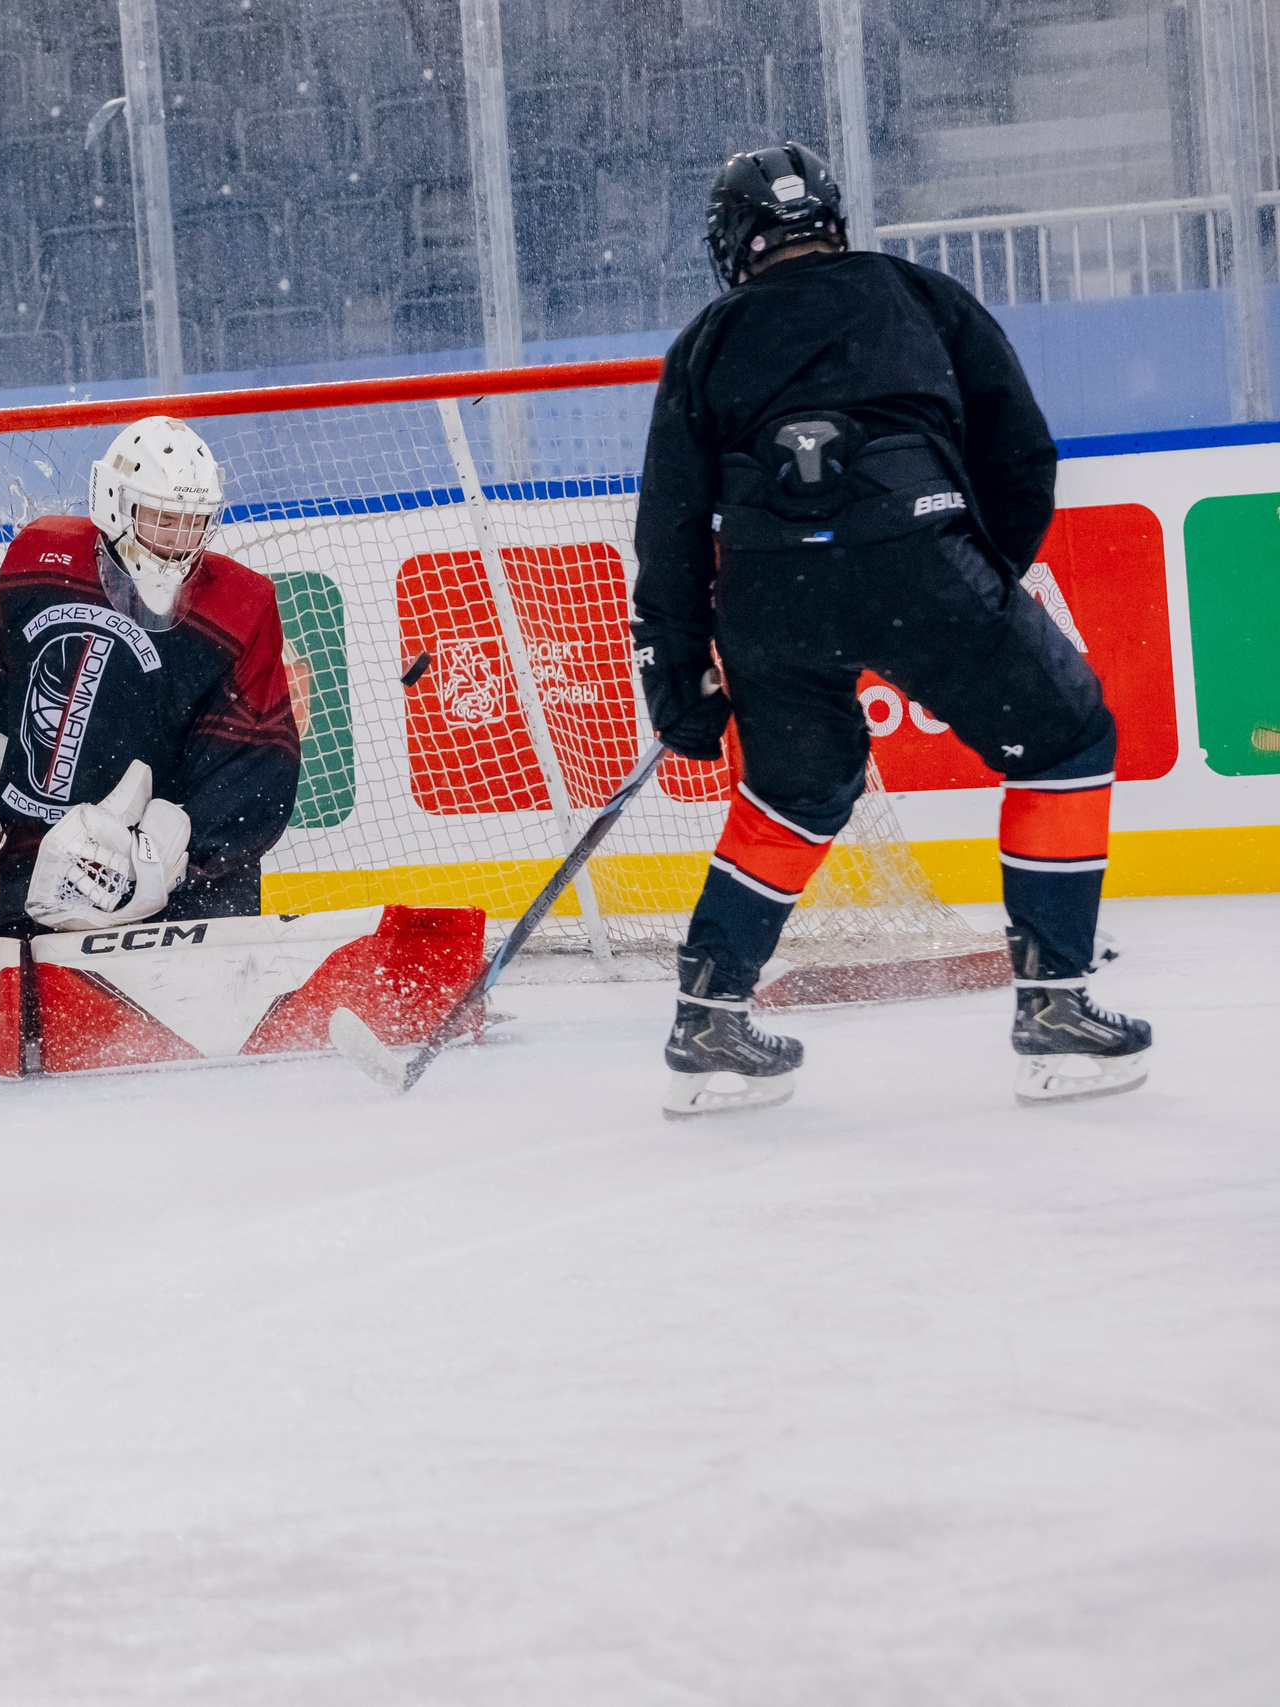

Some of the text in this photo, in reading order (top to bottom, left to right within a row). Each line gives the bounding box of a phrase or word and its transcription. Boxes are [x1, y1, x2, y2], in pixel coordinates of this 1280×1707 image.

[173, 485, 210, 494] BAUER
[27, 606, 157, 667] HOCKEY GOALIE
[527, 641, 585, 661] РОЕКТ
[531, 664, 567, 683] ЭРА
[537, 684, 599, 706] ОСКВЫ
[49, 637, 112, 798] DOMINATION
[80, 923, 209, 955] CCM
